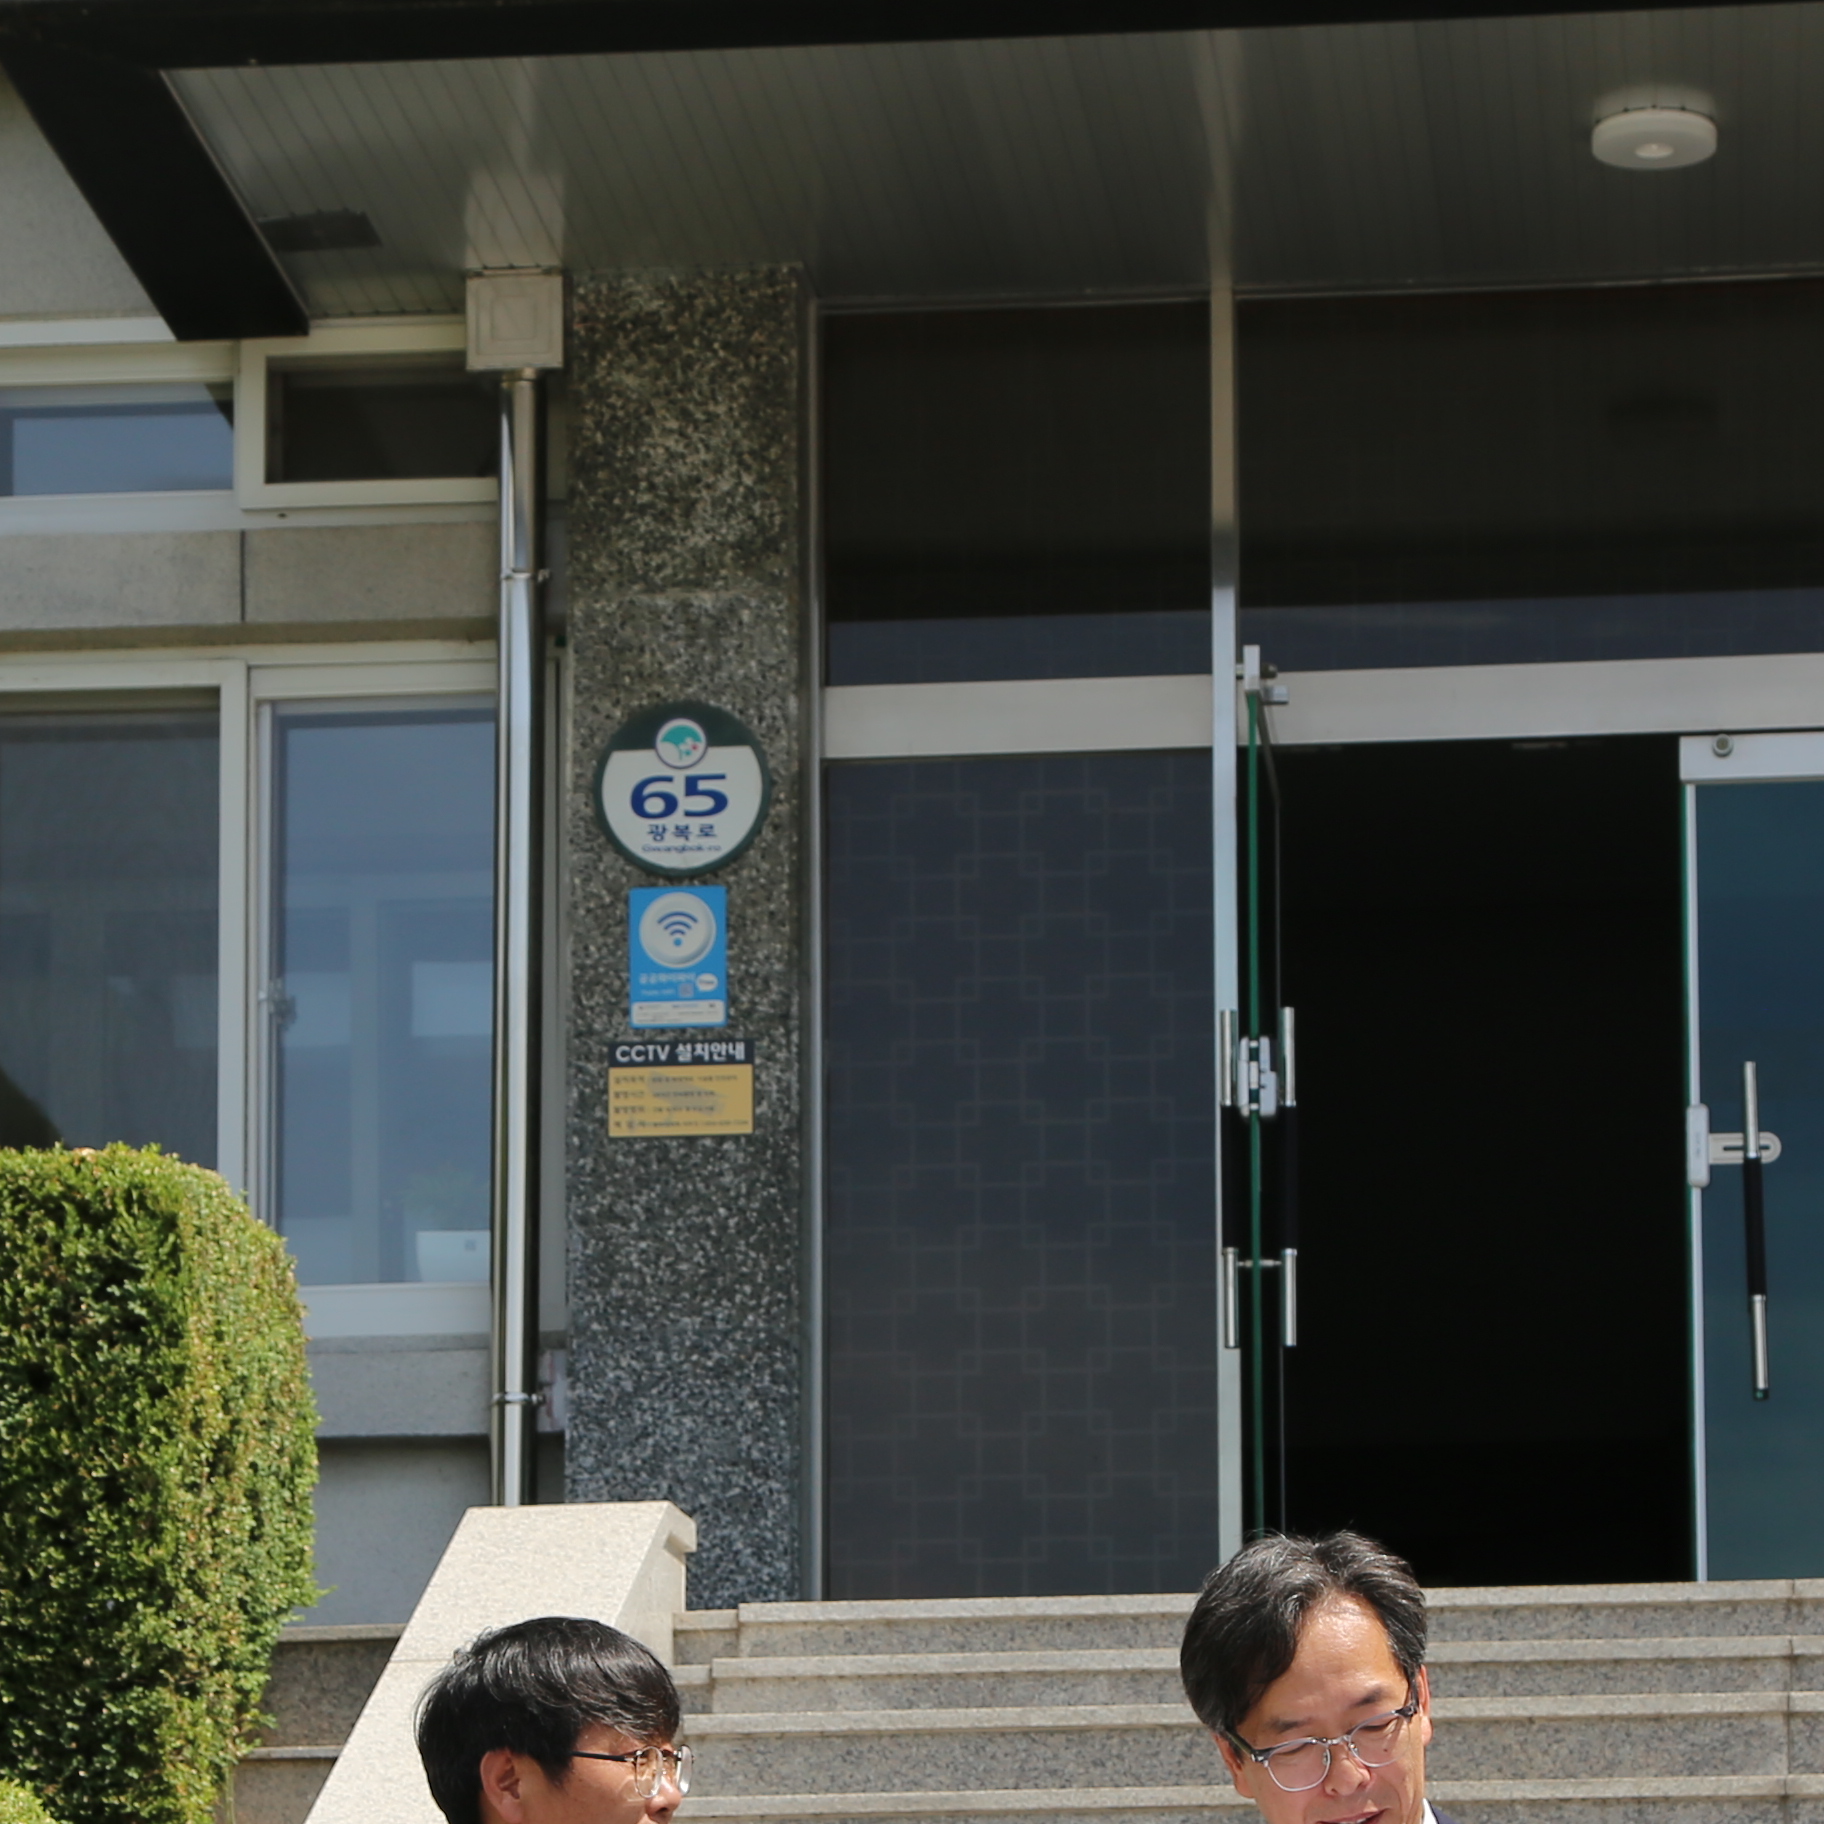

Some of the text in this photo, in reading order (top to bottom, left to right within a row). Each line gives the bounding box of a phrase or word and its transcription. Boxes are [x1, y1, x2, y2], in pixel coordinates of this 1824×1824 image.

[630, 773, 728, 819] 65
[647, 823, 718, 842] 광복로
[615, 1041, 746, 1063] CCTV 설치안내
